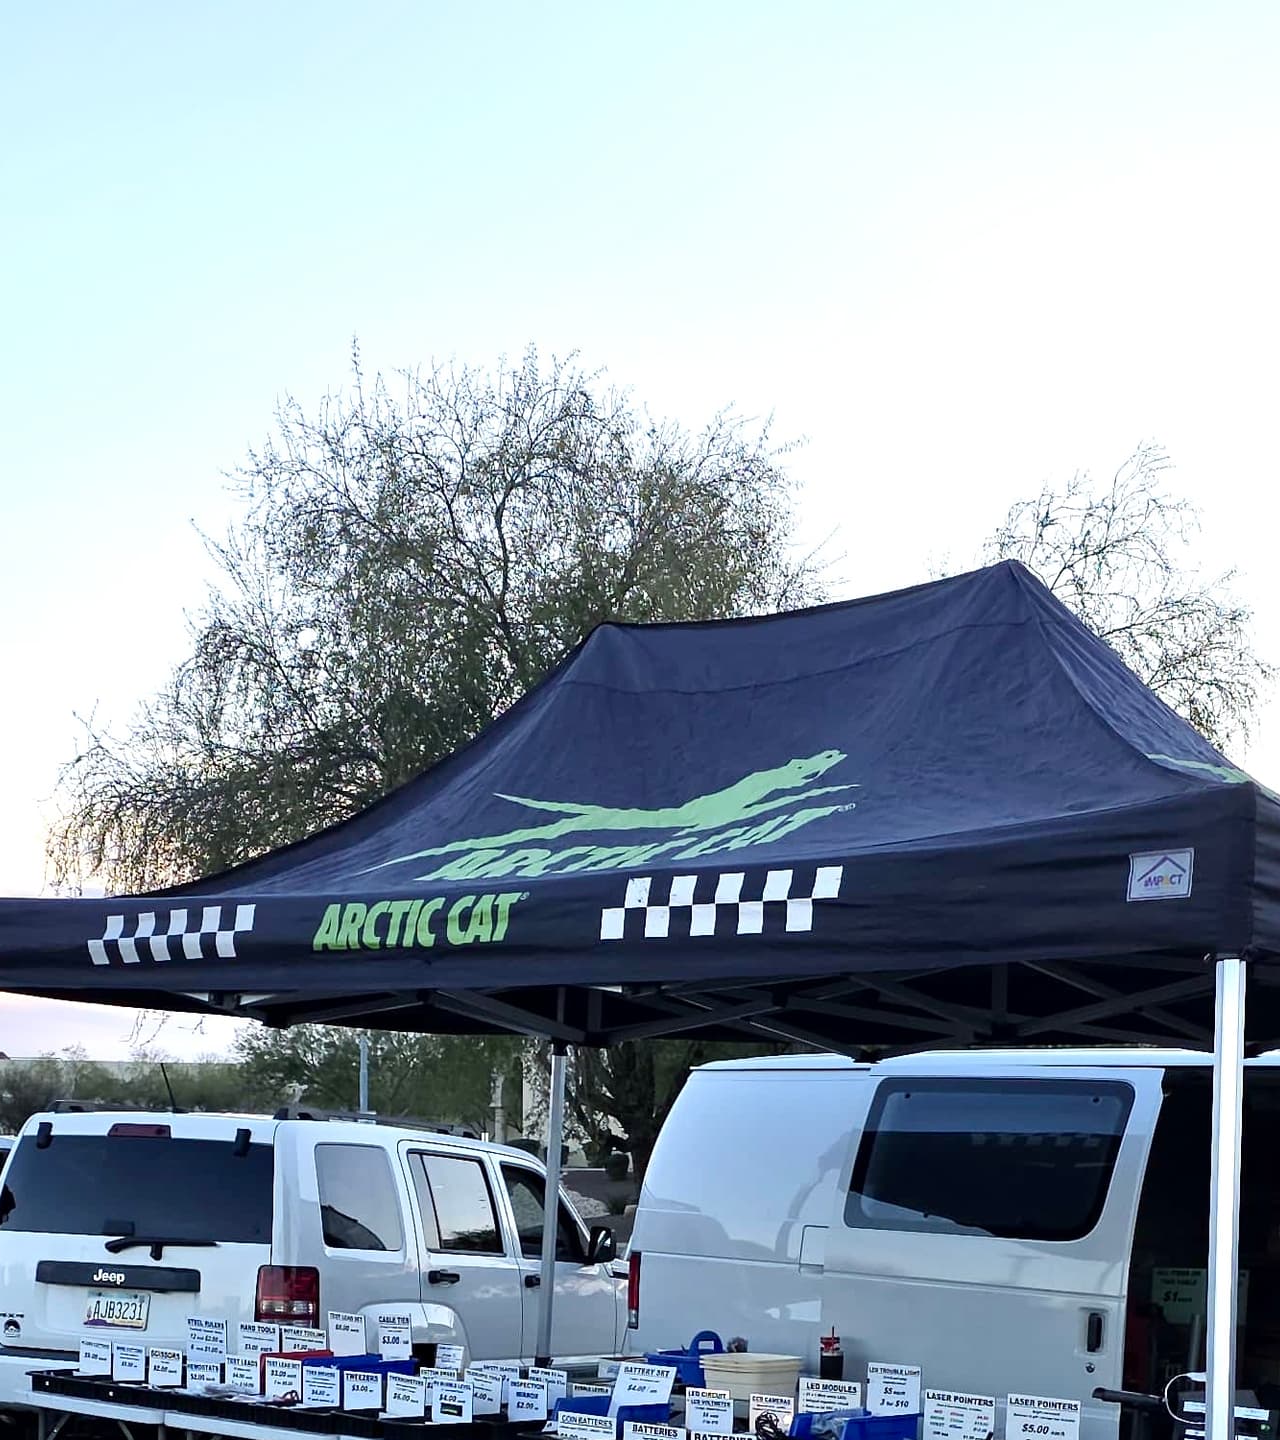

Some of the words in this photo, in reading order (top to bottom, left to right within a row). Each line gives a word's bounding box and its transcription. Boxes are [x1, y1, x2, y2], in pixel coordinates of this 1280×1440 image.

[313, 897, 440, 950] ARCTIC
[444, 892, 523, 946] CAT
[93, 1269, 125, 1284] Jeep
[93, 1300, 143, 1320] AJB3231
[345, 1373, 378, 1382] TWEEZERS
[624, 1367, 654, 1376] BATTERY
[510, 1380, 544, 1390] INSPECTION
[806, 1382, 820, 1390] LED
[821, 1384, 857, 1394] MODULES
[926, 1392, 952, 1402] LASER
[953, 1395, 994, 1407] POINTERS
[1009, 1397, 1035, 1406] LASER
[1037, 1400, 1079, 1411] POINTERS
[632, 1424, 678, 1437] BATTERIES
[1022, 1423, 1049, 1435] $5.00
